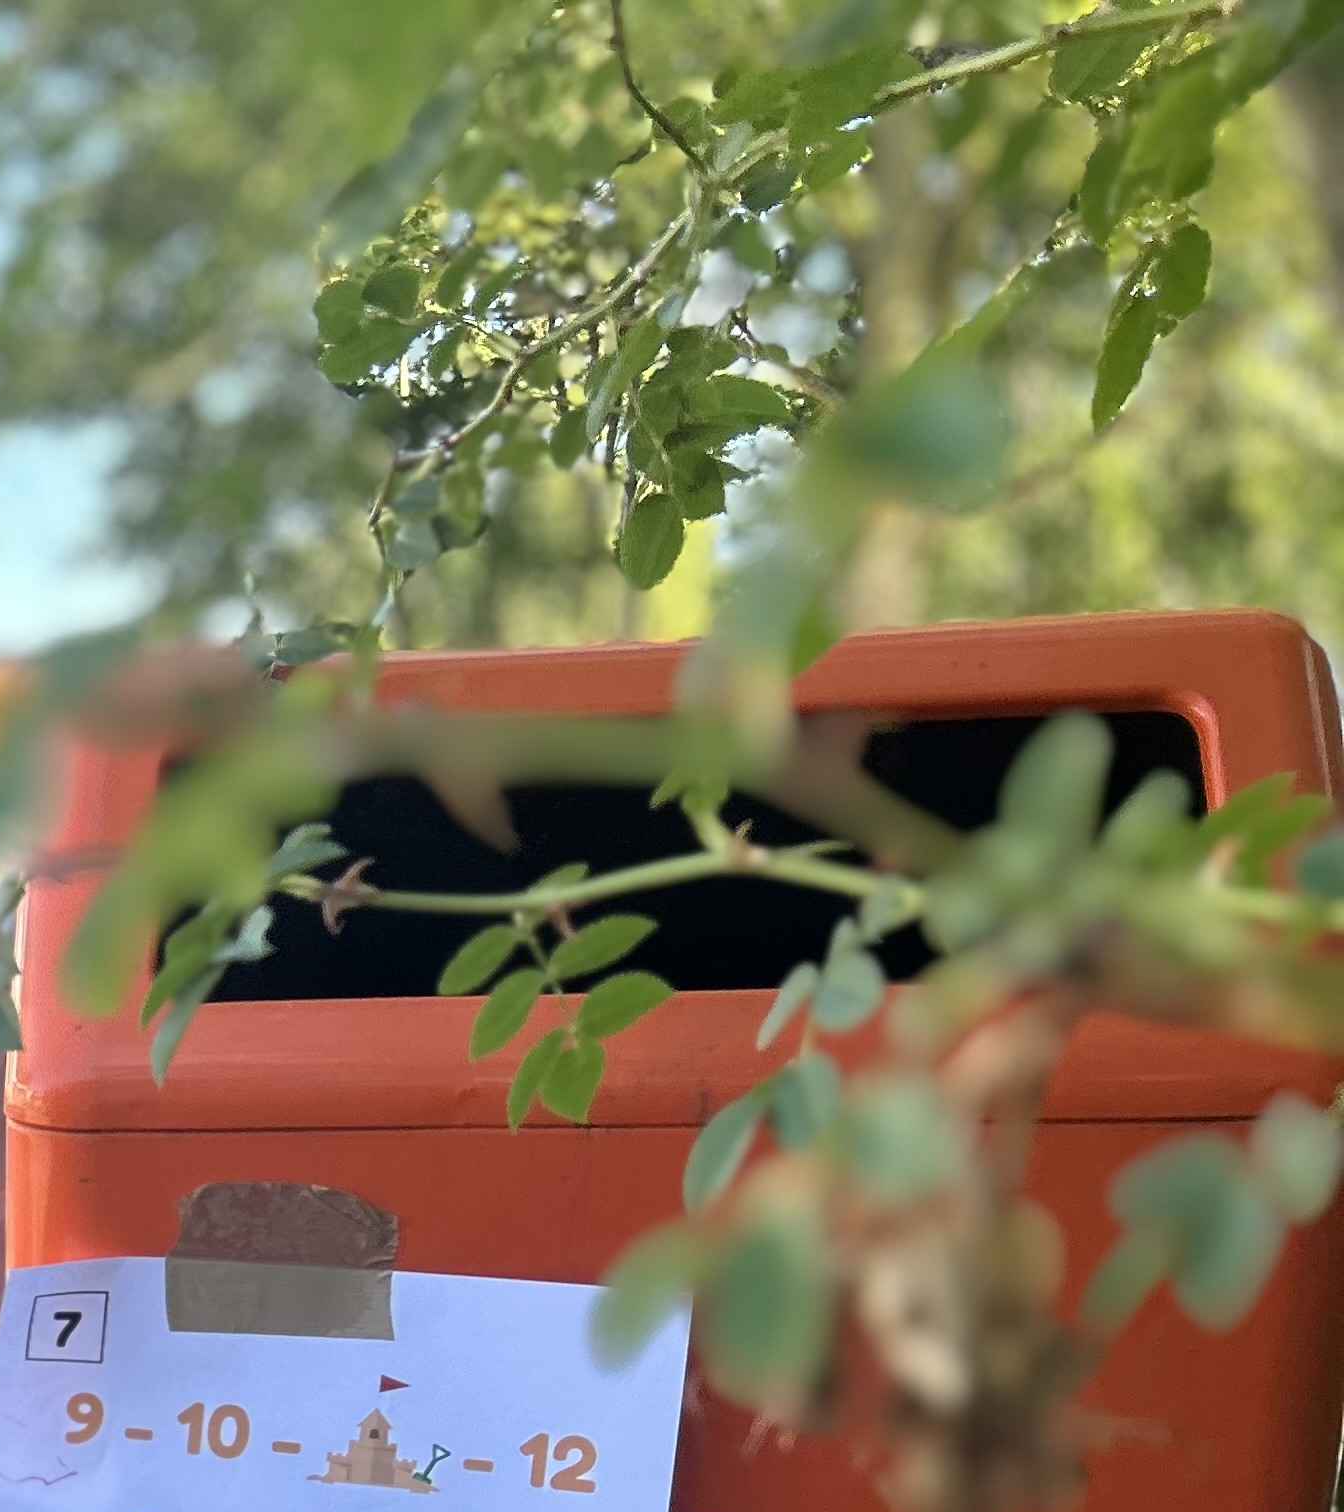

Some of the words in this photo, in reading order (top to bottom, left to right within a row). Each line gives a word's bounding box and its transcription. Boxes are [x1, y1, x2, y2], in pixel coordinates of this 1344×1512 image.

[53, 1311, 83, 1348] 7
[65, 1392, 105, 1445] 9
[177, 1401, 251, 1459] 10
[519, 1432, 598, 1493] 12
